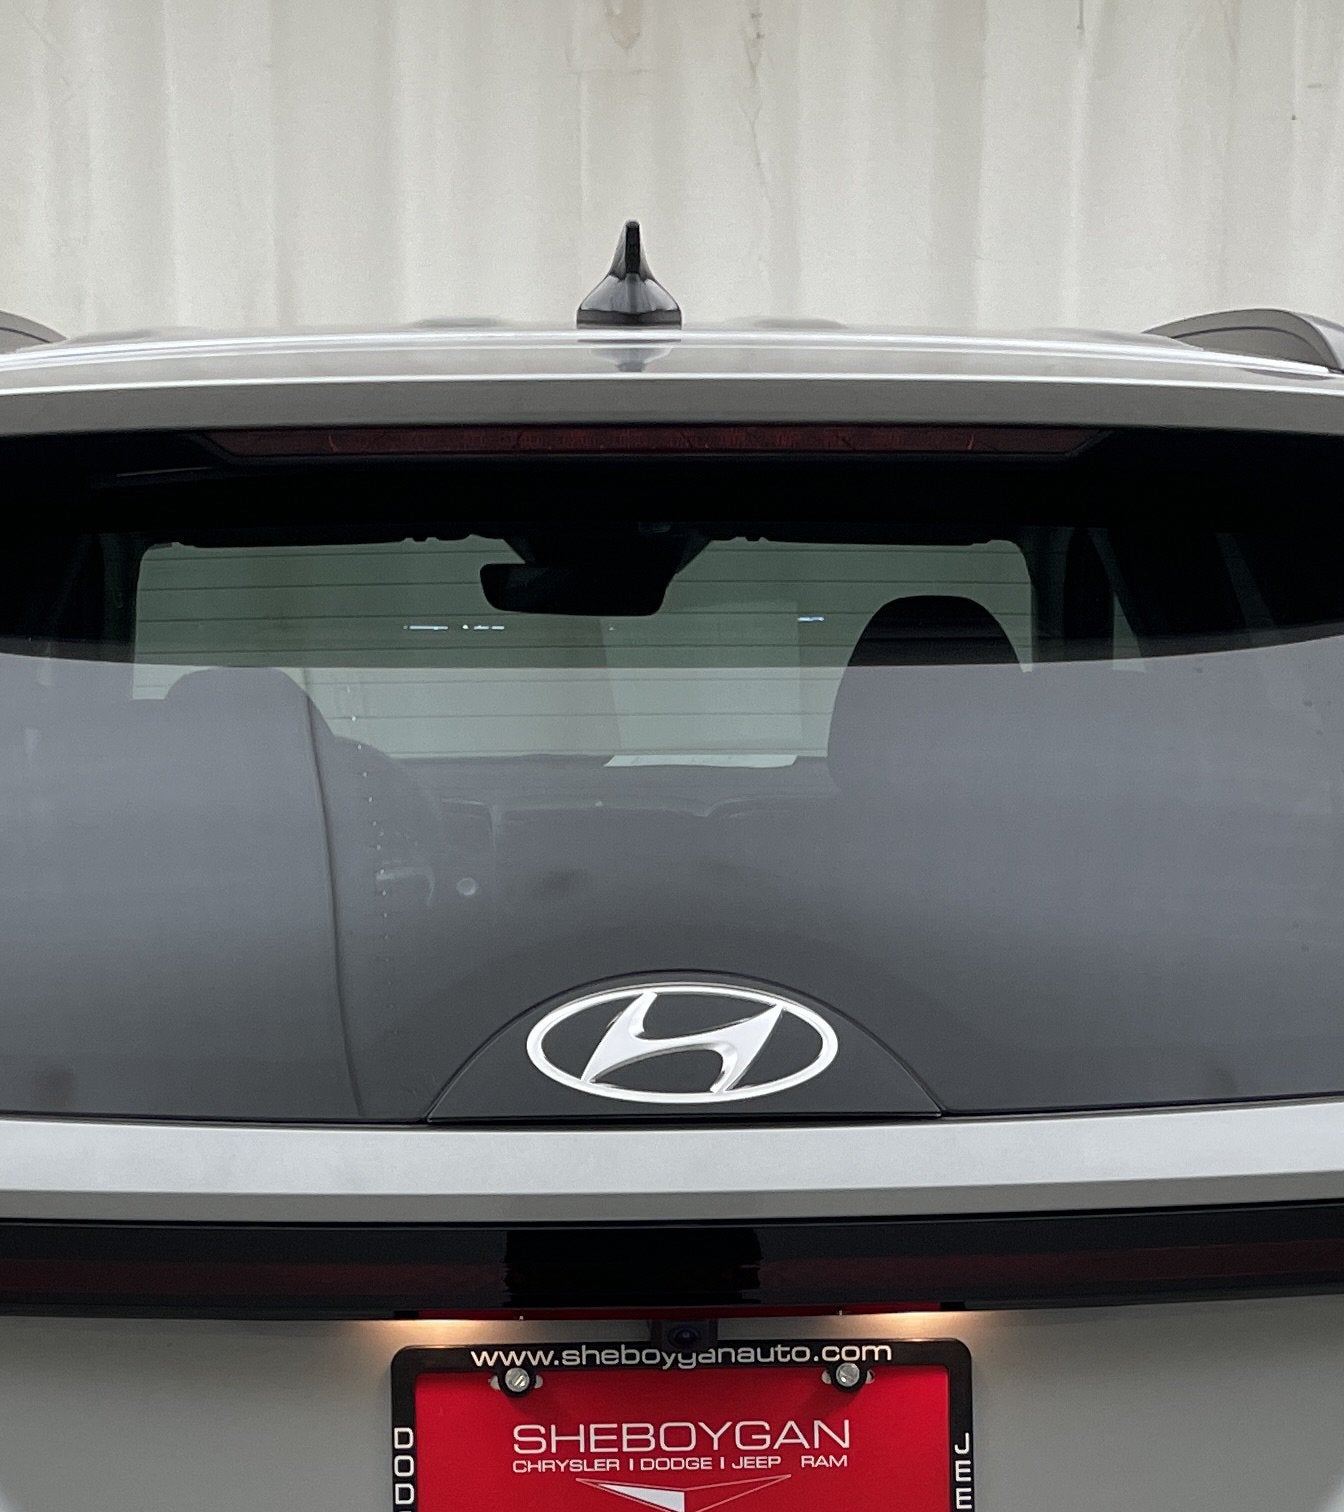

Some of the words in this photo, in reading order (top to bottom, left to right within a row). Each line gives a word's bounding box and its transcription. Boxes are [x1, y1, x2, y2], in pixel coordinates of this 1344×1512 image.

[513, 1419, 850, 1454] SHEBOYGAN
[512, 1458, 620, 1474] CHRYSLER
[640, 1457, 713, 1471] DODGE
[731, 1455, 782, 1470] JEEP
[801, 1454, 848, 1468] RAM
